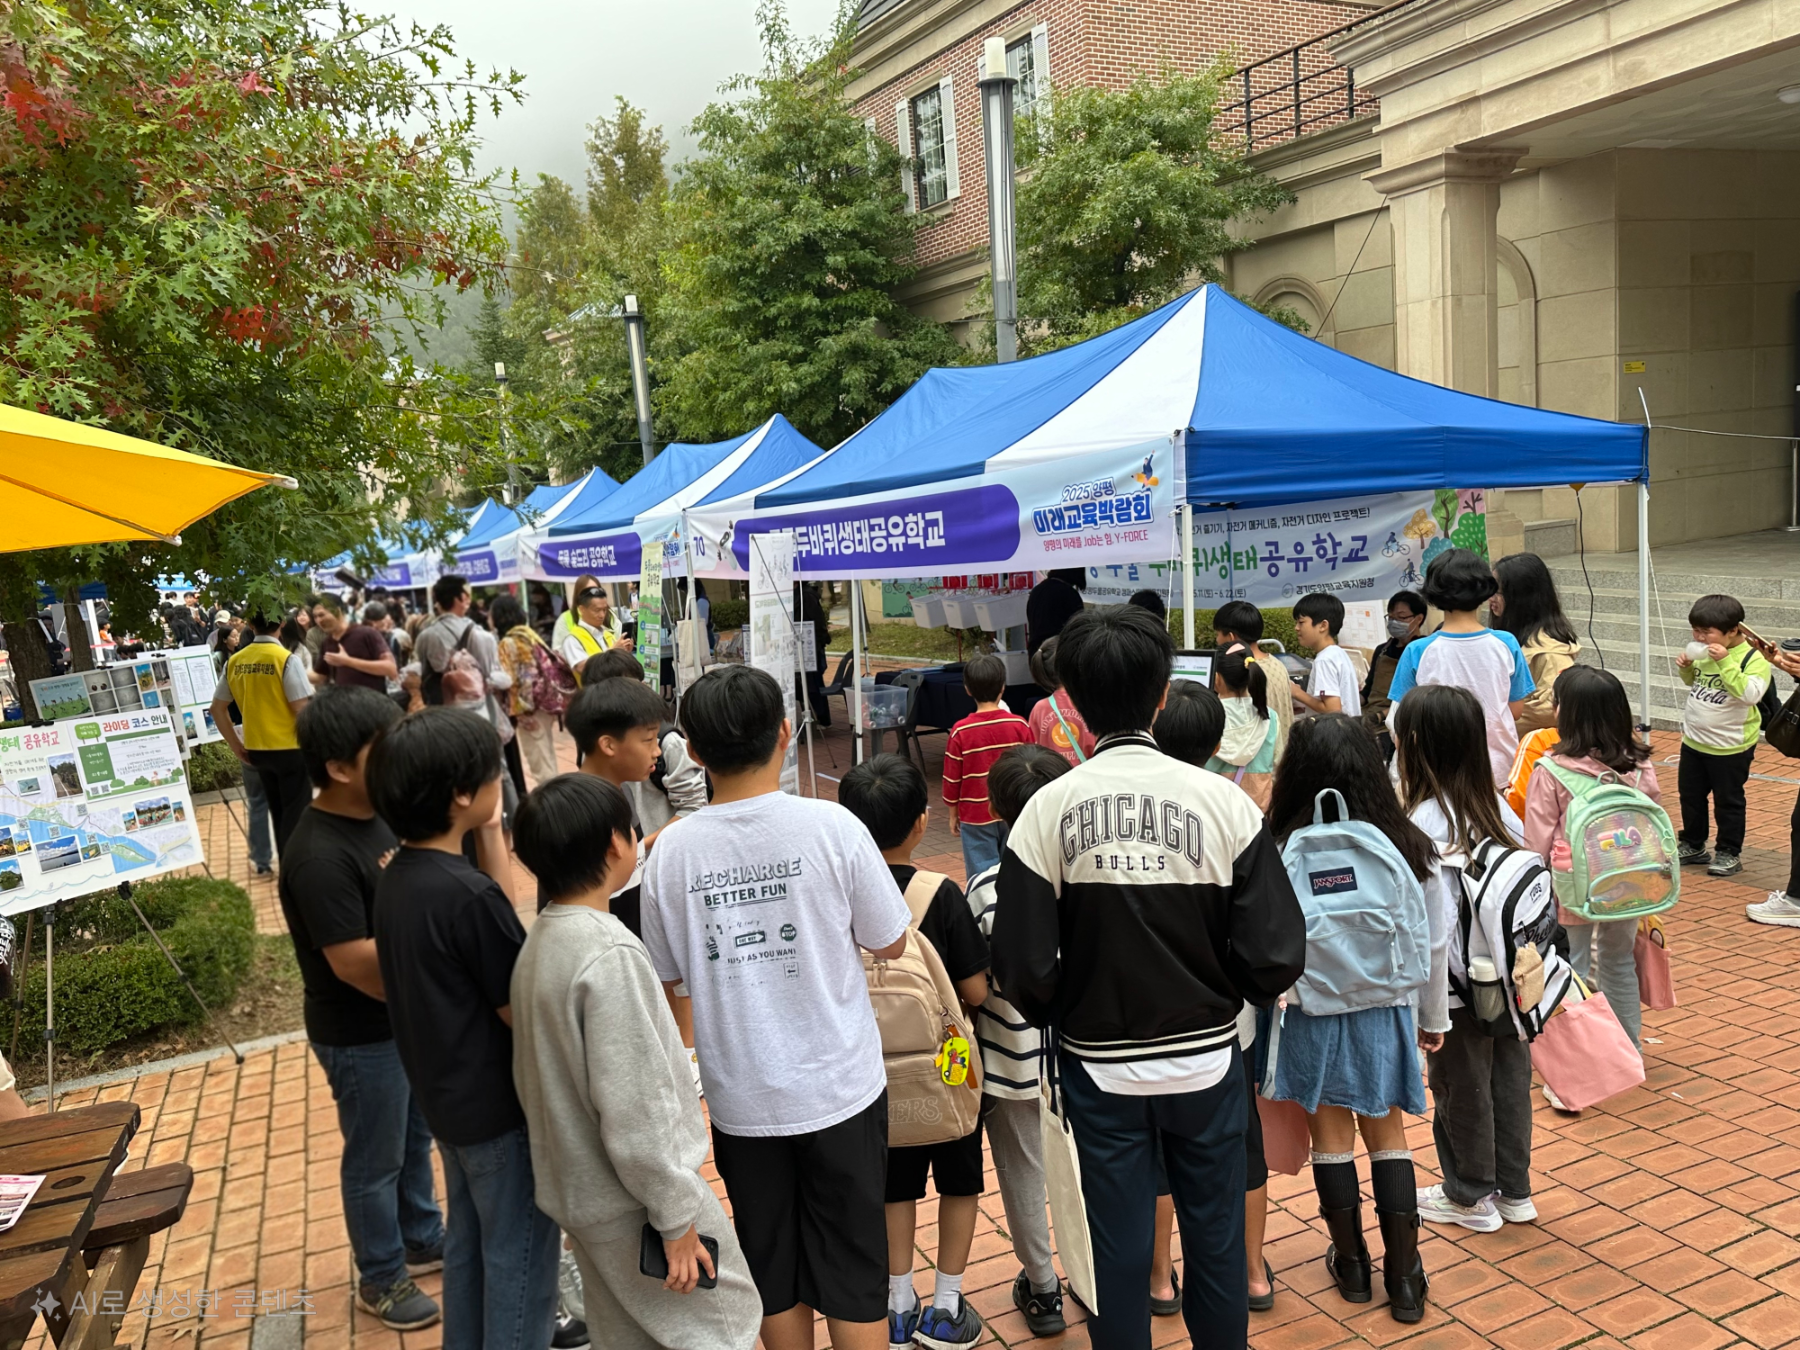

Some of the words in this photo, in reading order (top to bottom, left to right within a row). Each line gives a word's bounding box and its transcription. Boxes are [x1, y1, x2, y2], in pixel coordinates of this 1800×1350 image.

[1062, 485, 1091, 502] 2025
[1092, 479, 1115, 497] 양평
[1033, 492, 1152, 533] 미래교육박람회
[1226, 521, 1247, 533] 자전거
[1282, 515, 1305, 527] 자전거
[1306, 511, 1332, 525] 디자인
[1333, 507, 1371, 522] 프로젝트!
[693, 536, 706, 557] 10
[769, 511, 946, 558] 두바퀴생태공유학교
[1115, 529, 1149, 543] Y-FORCE
[589, 544, 617, 568] 공유학교
[103, 719, 130, 732] 라이딩
[131, 716, 149, 728] 코스
[151, 714, 168, 726] 안내
[24, 731, 60, 750] 공유학교
[1059, 794, 1204, 869] CHICAGO
[1597, 826, 1642, 852] FILA
[688, 857, 802, 893] RECHARGE
[1095, 855, 1165, 871] BULLS
[704, 888, 757, 907] BETTER
[761, 883, 787, 898] FUN
[747, 953, 758, 962] AS
[759, 950, 775, 959] YOU
